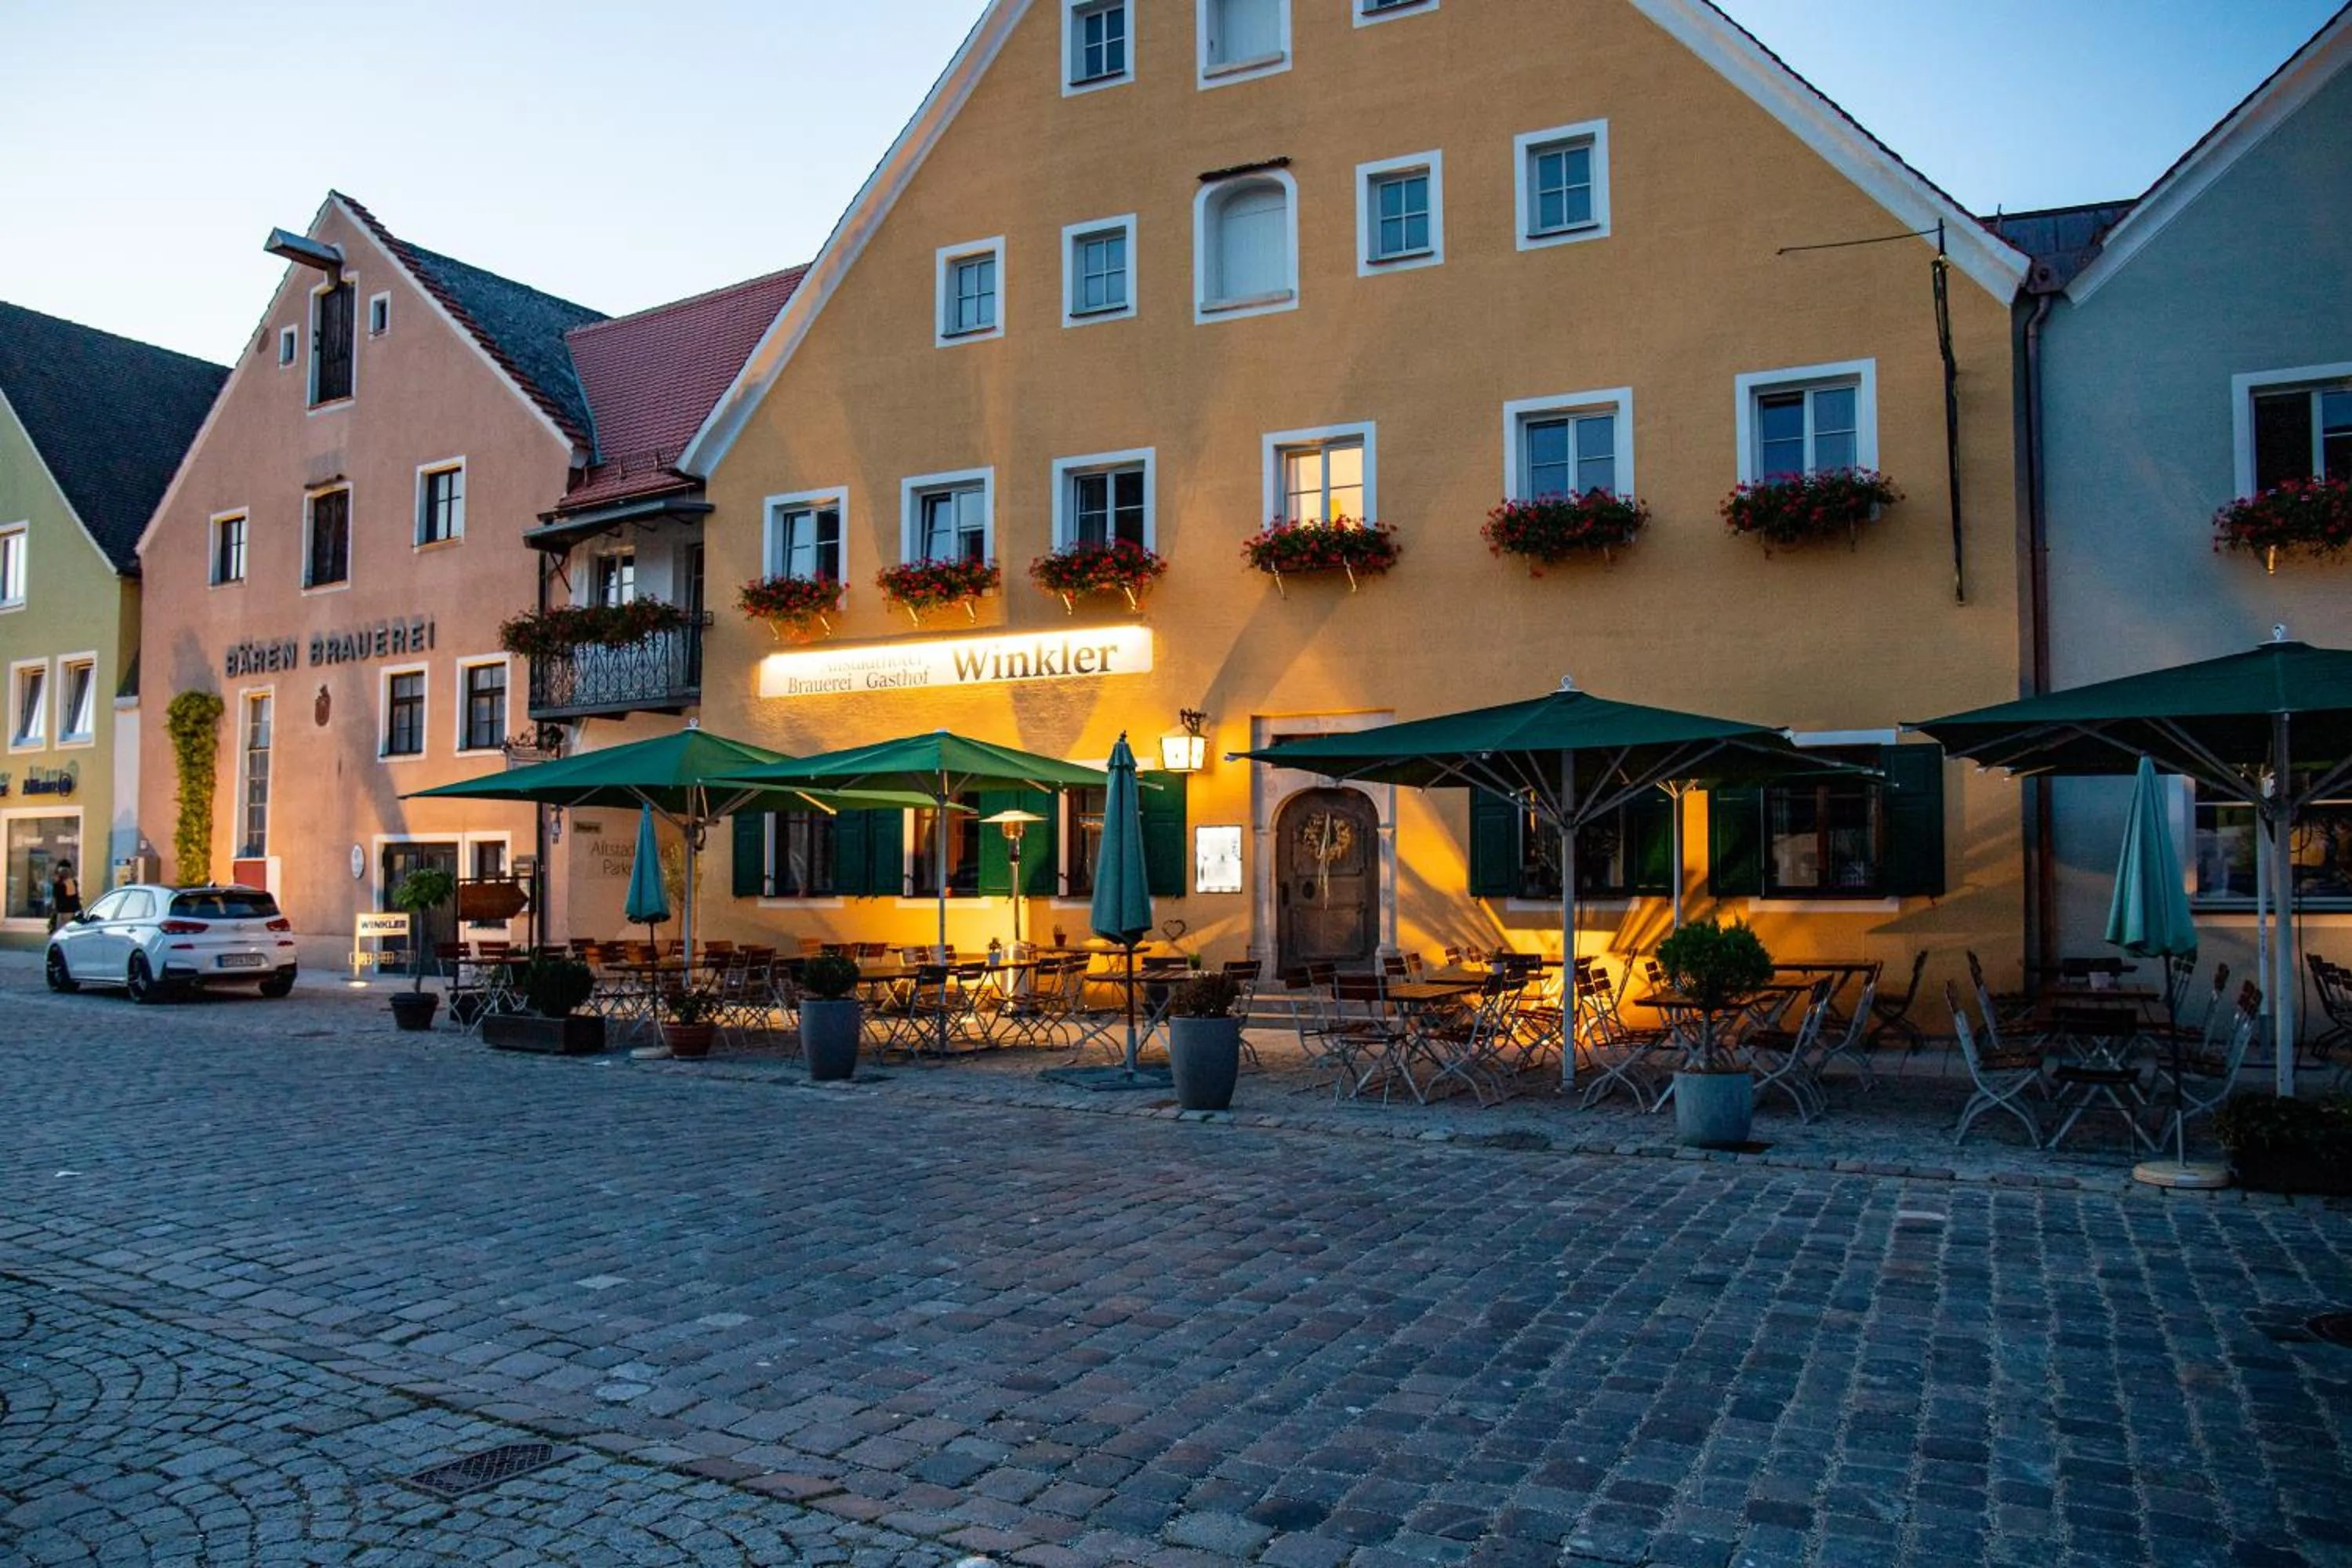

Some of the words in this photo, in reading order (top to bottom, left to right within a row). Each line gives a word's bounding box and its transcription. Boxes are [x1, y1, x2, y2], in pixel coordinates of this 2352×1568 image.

[226, 637, 299, 678] BÄREN
[309, 615, 435, 666] BRAUEREI
[952, 638, 1118, 681] Winkler
[788, 673, 852, 694] Brauerei
[866, 665, 931, 689] Gasthof
